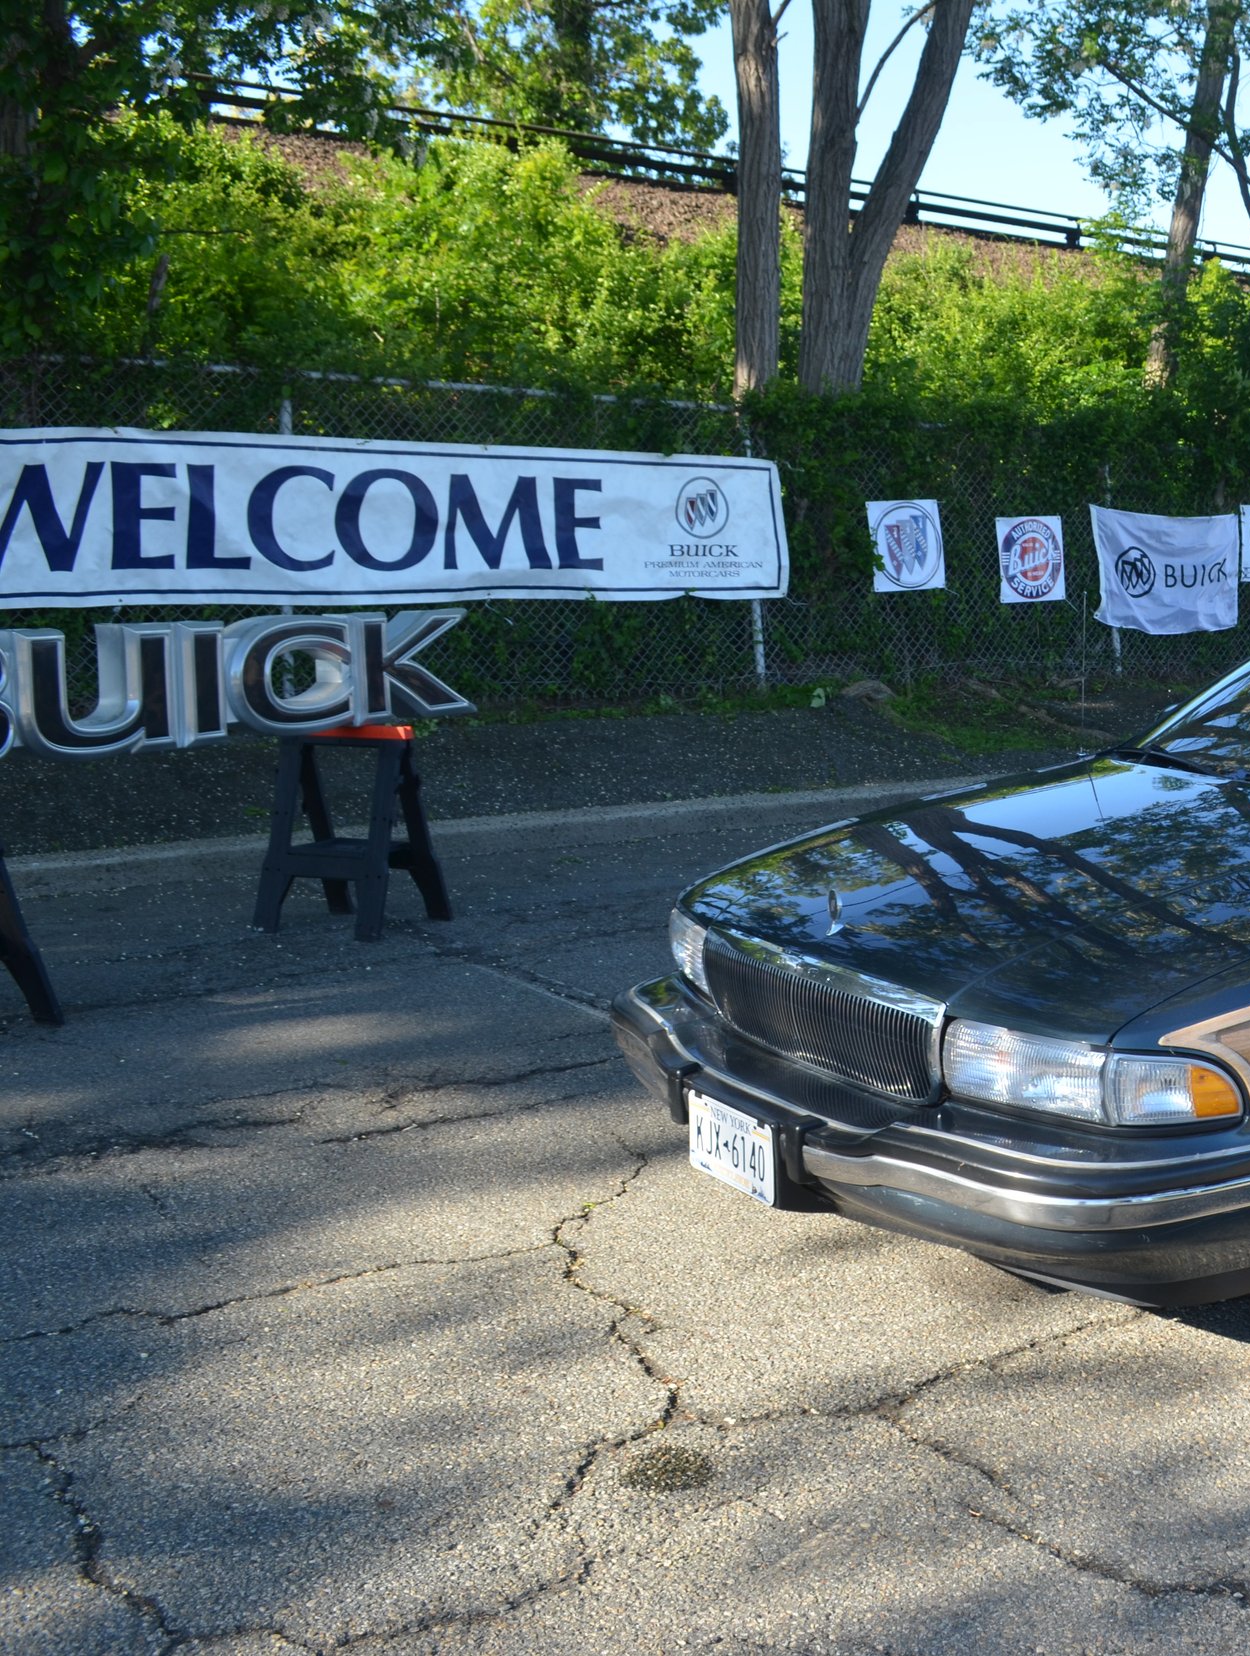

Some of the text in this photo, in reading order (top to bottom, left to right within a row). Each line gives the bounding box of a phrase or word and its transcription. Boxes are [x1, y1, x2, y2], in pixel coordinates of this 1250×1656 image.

[0, 460, 604, 572] WELCOME
[1011, 521, 1052, 540] AUTHORIZED
[668, 544, 739, 557] BUICK
[1007, 538, 1055, 577] Buick
[644, 560, 763, 569] PREMIUM AMERICAN
[669, 570, 741, 578] MOTORCARS
[1164, 558, 1228, 588] BUICK
[1011, 577, 1055, 597] SERVICE
[710, 1106, 752, 1136] NEW YORK
